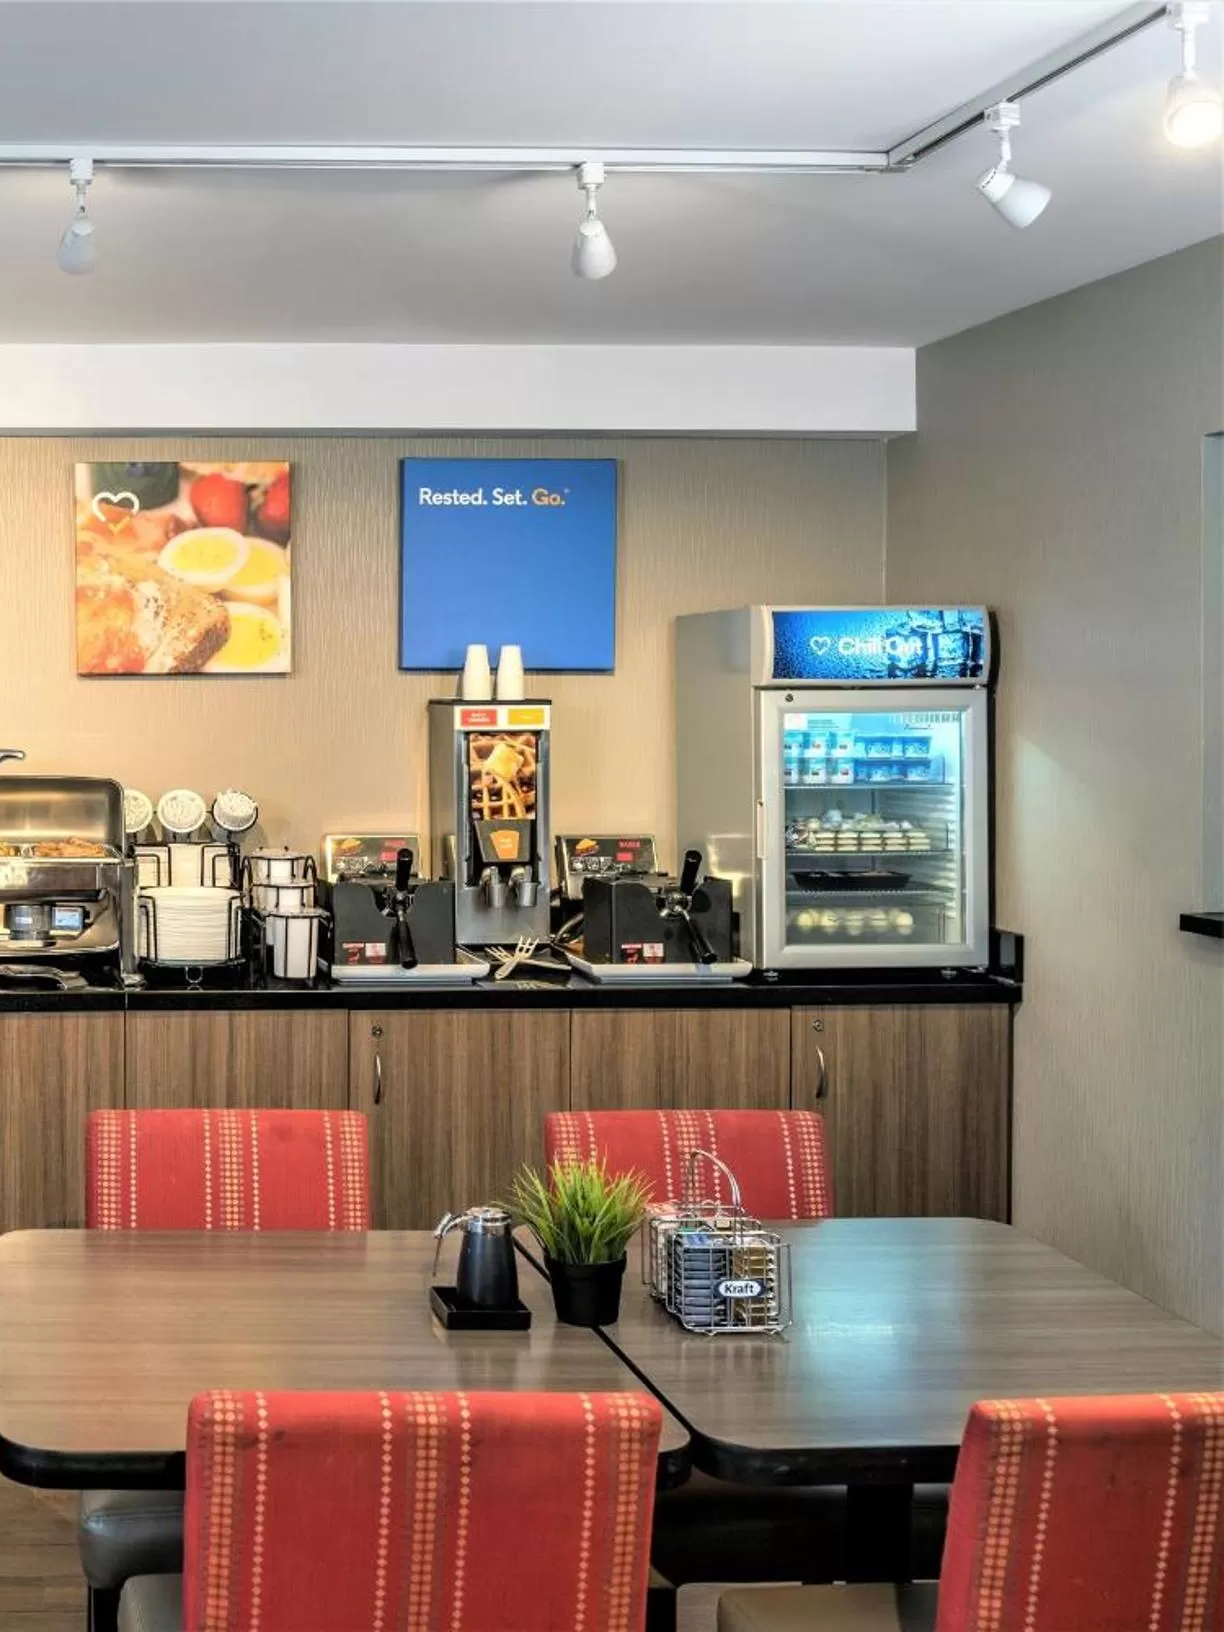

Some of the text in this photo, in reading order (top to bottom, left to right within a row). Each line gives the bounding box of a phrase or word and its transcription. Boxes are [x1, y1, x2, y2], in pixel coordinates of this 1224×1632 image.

[419, 487, 488, 505] Rested.
[492, 487, 527, 505] Set.
[724, 1283, 754, 1294] Kraft
